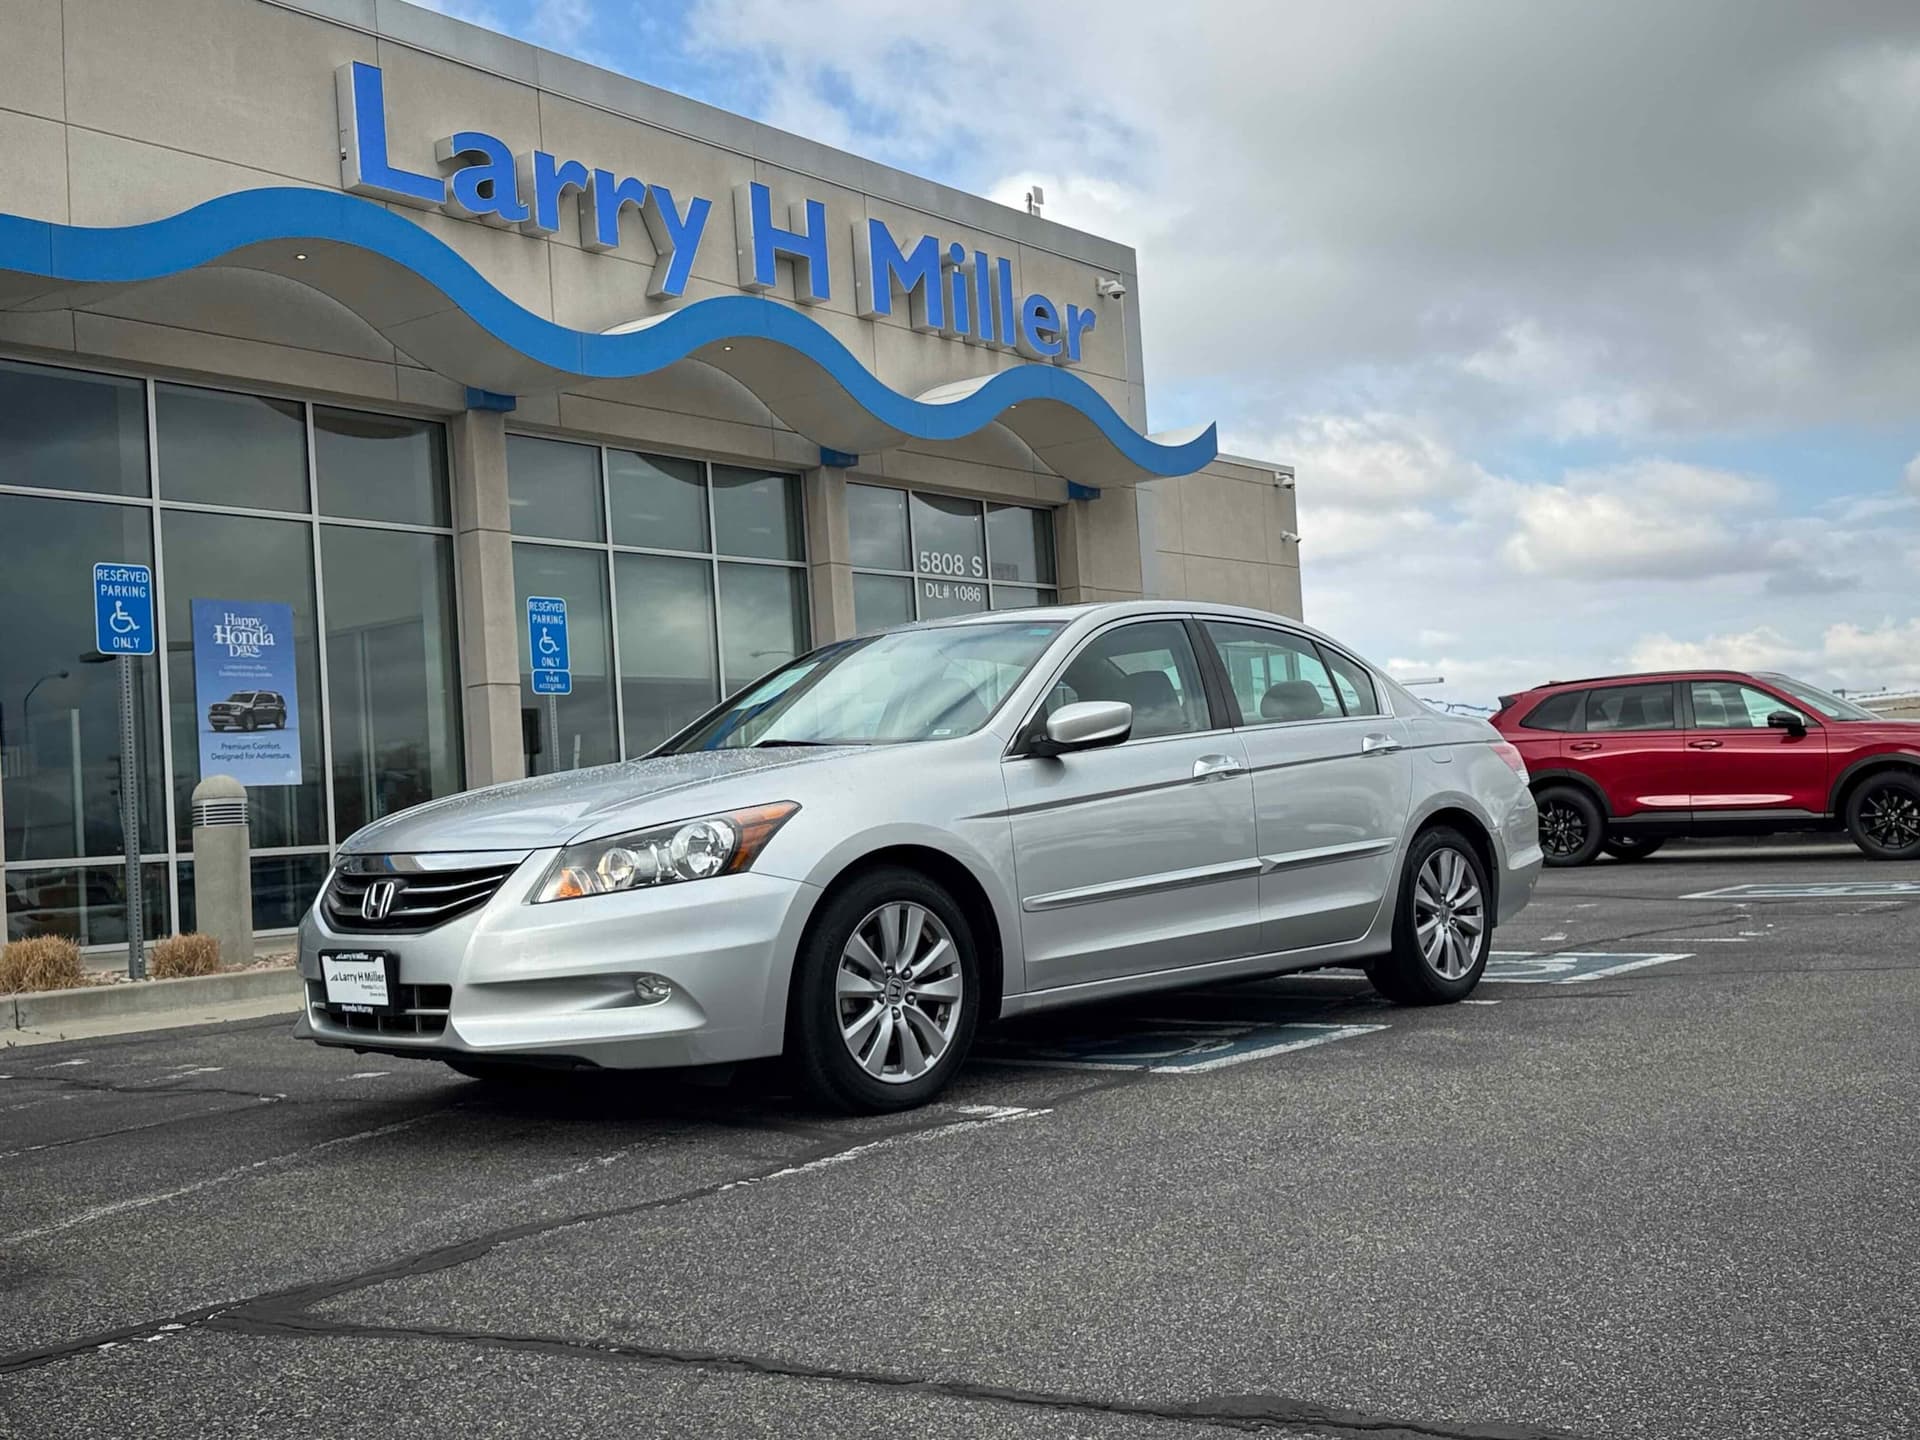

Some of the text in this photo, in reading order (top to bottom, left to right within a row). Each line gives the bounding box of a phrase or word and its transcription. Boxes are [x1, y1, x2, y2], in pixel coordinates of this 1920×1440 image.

[350, 59, 1097, 364] Larry H Miller
[920, 551, 983, 577] 5808 S
[96, 569, 149, 583] RESERVED
[101, 584, 147, 598] PARKING
[925, 582, 981, 602] DL# 1086
[529, 601, 565, 613] RESERVED
[224, 612, 263, 630] Happy
[532, 614, 564, 625] PARKING
[213, 624, 275, 646] Honda
[112, 636, 140, 649] ONLY
[229, 644, 261, 658] Days
[541, 656, 560, 668] ONLY
[545, 674, 560, 683] VAN
[339, 971, 384, 984] Larry H Miller
